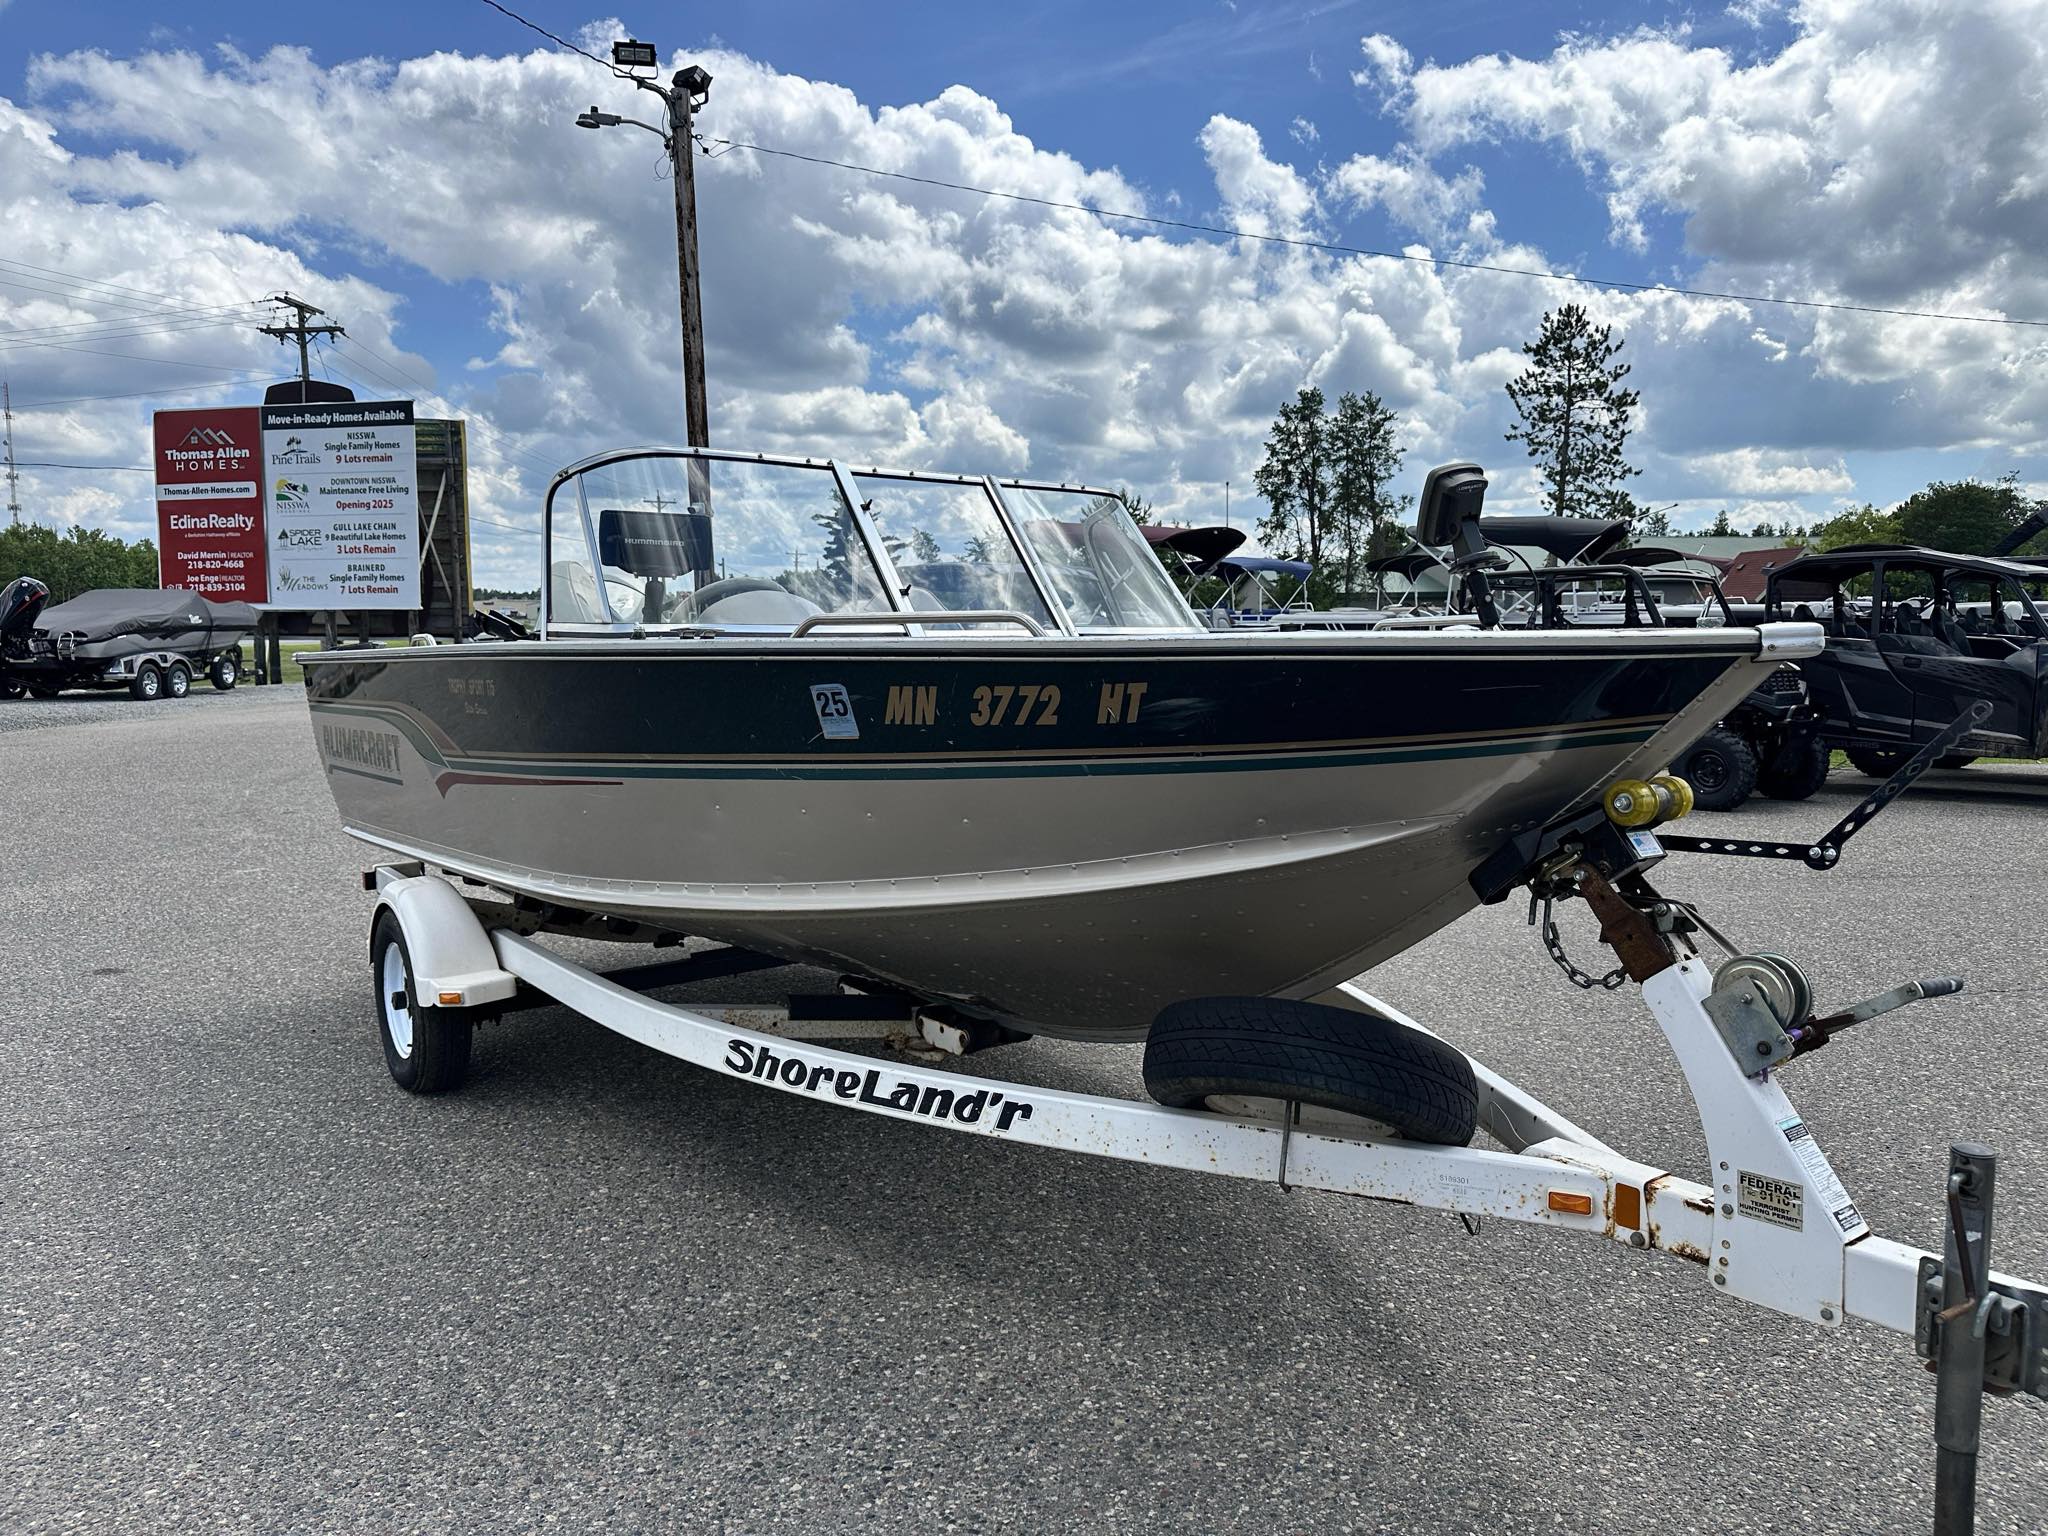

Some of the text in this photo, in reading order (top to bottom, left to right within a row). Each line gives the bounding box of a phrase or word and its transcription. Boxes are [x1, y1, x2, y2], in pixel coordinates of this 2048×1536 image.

[268, 410, 405, 425] Move-in-Ready Homes Available
[347, 432, 376, 440] NISSWA
[324, 441, 400, 452] Single Family Homes
[165, 447, 250, 460] Thomas Allen
[344, 455, 362, 463] Lots
[362, 454, 392, 462] remain
[272, 454, 320, 465] Pine Trails
[176, 460, 239, 472] HOMES
[164, 486, 250, 496] Thomas-Allen-Homes.com
[320, 487, 366, 495] Maintenance
[386, 486, 409, 494] Living
[336, 500, 394, 511] Opening 2025
[170, 513, 254, 531] Edina Realty
[333, 524, 352, 532] GULL
[290, 537, 322, 546] LAKE
[331, 533, 362, 541] Beautiful
[624, 538, 684, 546] HUMMINBIRD
[336, 546, 342, 554] 3
[344, 545, 362, 554] Lots
[364, 544, 396, 554] Remain
[178, 552, 198, 560] David
[200, 551, 226, 559] Mernin
[188, 560, 244, 569] 218-820-4668
[348, 564, 386, 572] BRAINERD
[186, 574, 199, 582] Joe
[200, 574, 218, 583] Enge
[330, 573, 404, 583] Single Family Homes
[189, 583, 246, 592] 218-839-3104
[340, 585, 398, 594] 7 Lots Remain
[816, 692, 848, 717] 25
[884, 682, 1148, 726] MN 3772 HT
[724, 1038, 1034, 1131] ShoreLand'r
[1740, 1174, 1800, 1200] FEDERAL
[1750, 1200, 1790, 1215] TERRORIST
[1740, 1202, 1799, 1224] HUNTING PERMIT
